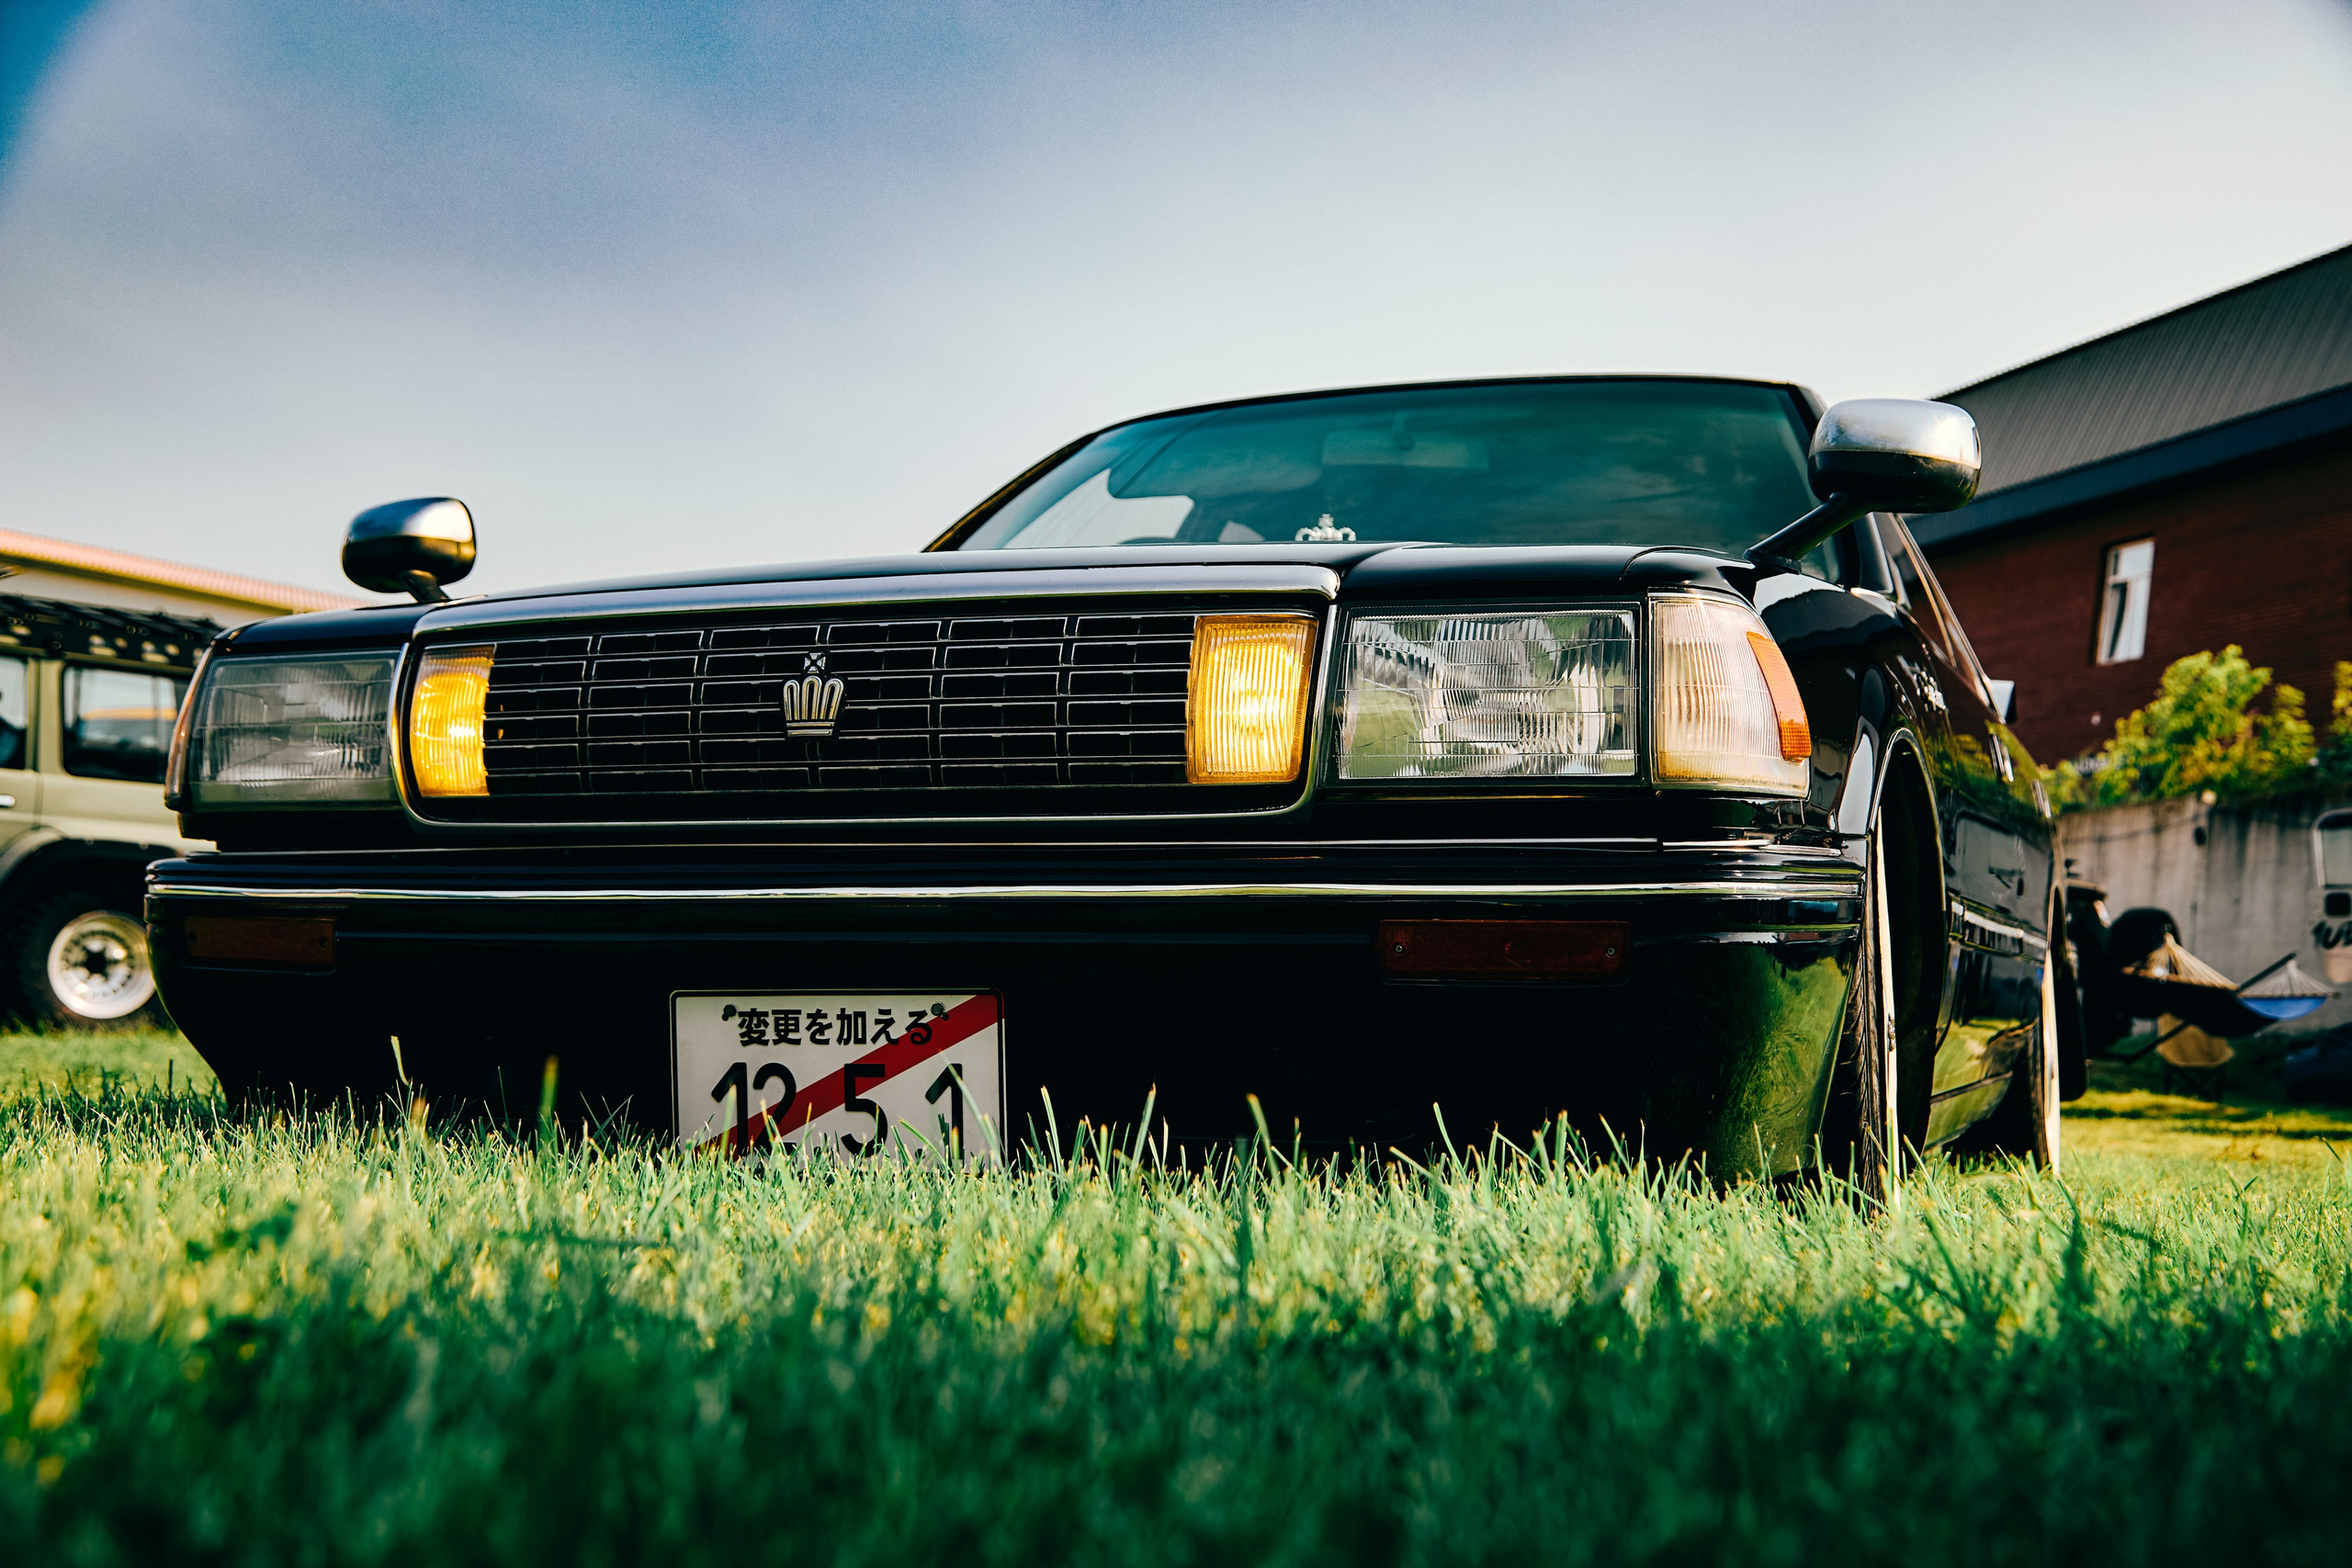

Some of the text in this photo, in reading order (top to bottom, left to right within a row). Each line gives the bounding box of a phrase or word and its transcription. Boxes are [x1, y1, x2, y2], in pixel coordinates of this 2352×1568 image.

[738, 1008, 933, 1045] 変更を加える
